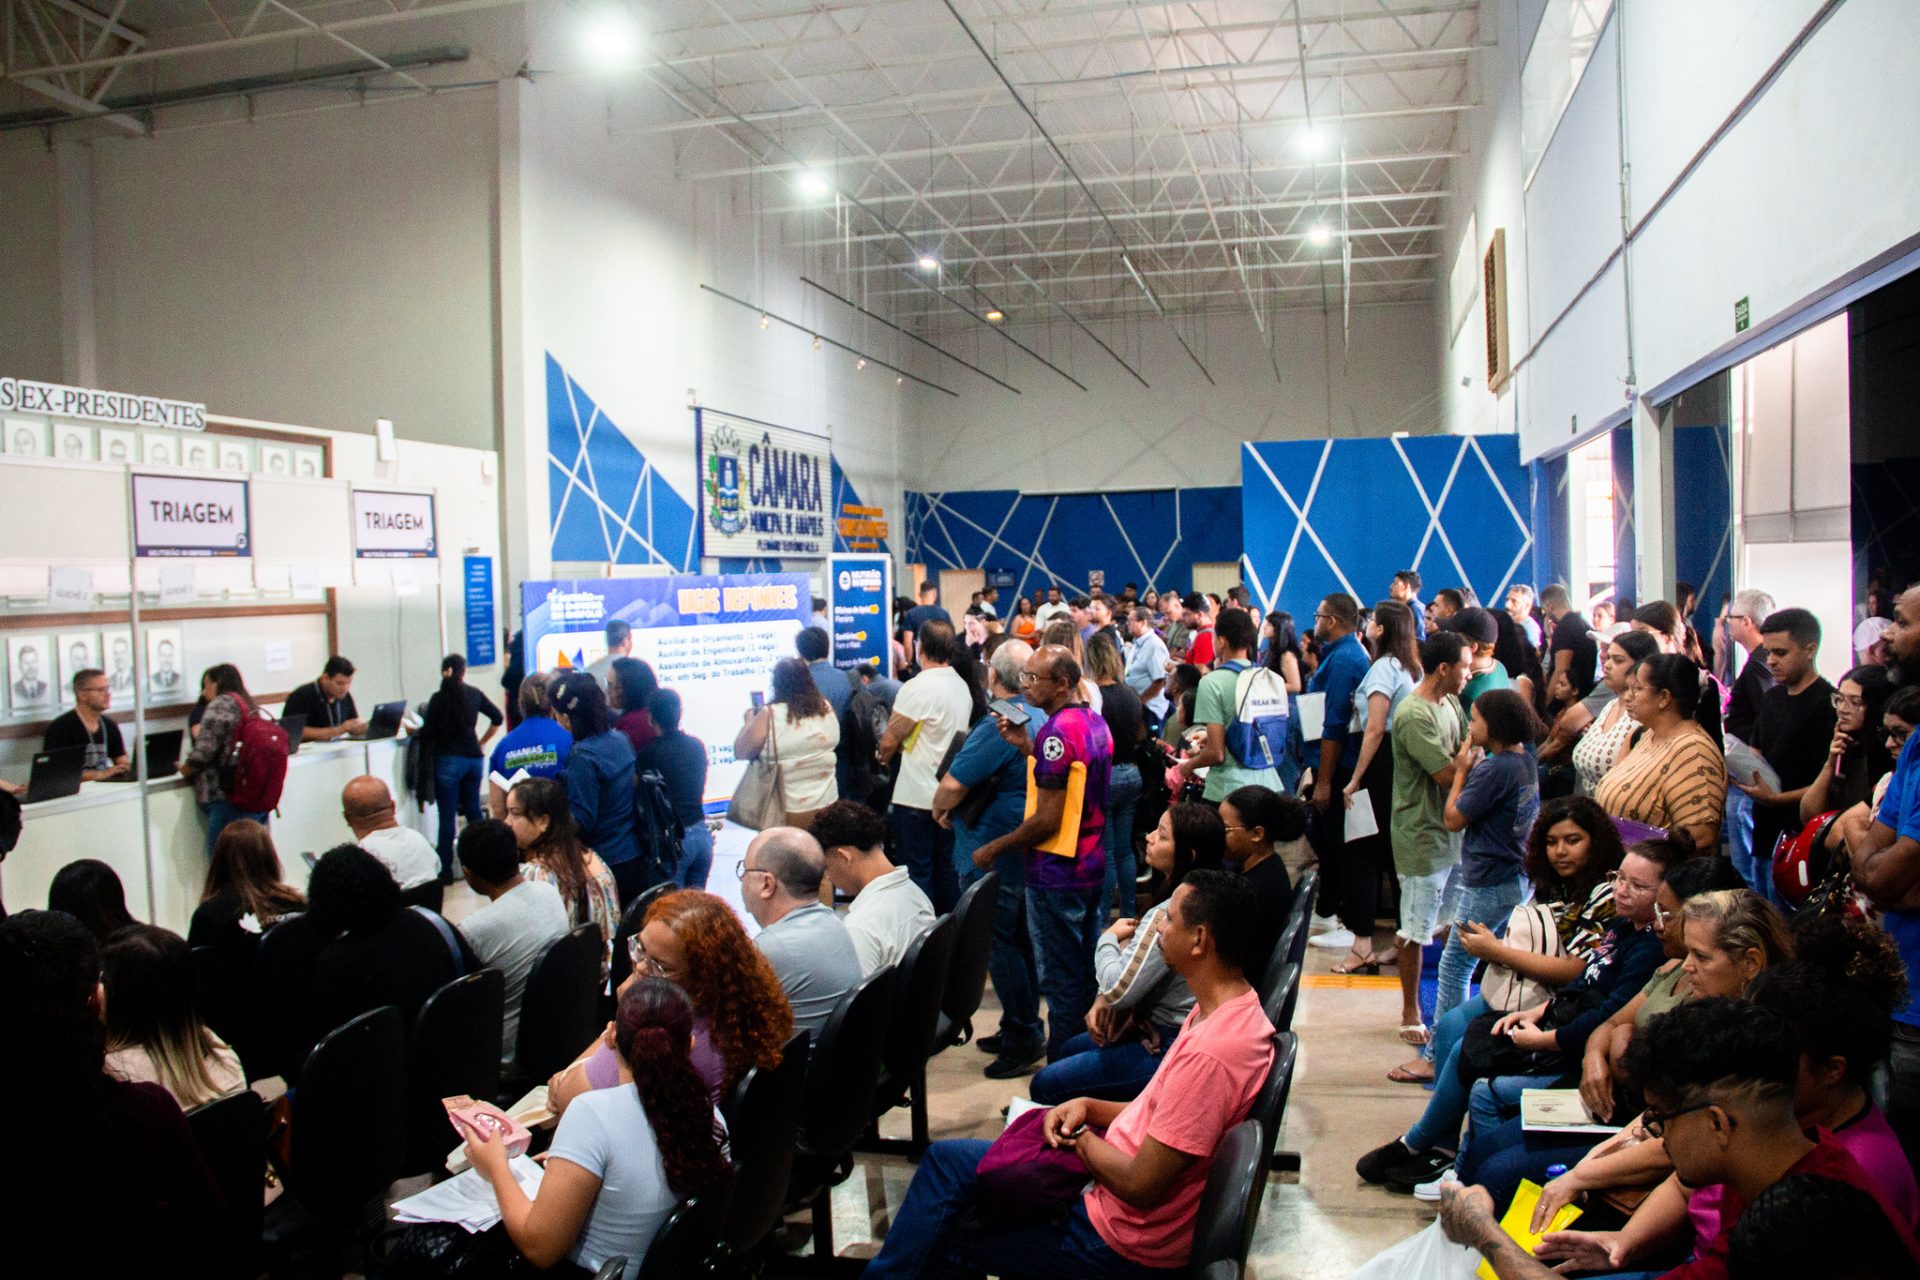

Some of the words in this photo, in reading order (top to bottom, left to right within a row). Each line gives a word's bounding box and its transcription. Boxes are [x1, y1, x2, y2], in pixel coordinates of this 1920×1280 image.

[20, 385, 205, 428] EX-PRESIDENTES
[749, 431, 823, 512] CÂMARA
[150, 500, 234, 524] TRIAGEM
[364, 512, 424, 530] TRIAGEM
[678, 588, 720, 614] VAGAS
[723, 583, 798, 612] DISPONÍVEIS
[658, 637, 688, 646] Auxiliar
[702, 633, 744, 643] Orçamento
[658, 648, 688, 658] Auxiliar
[691, 648, 700, 656] de
[703, 645, 745, 656] Engenharia
[658, 661, 699, 670] Assistente
[714, 655, 763, 666] Almoxarifado
[723, 667, 756, 677] Trabalho
